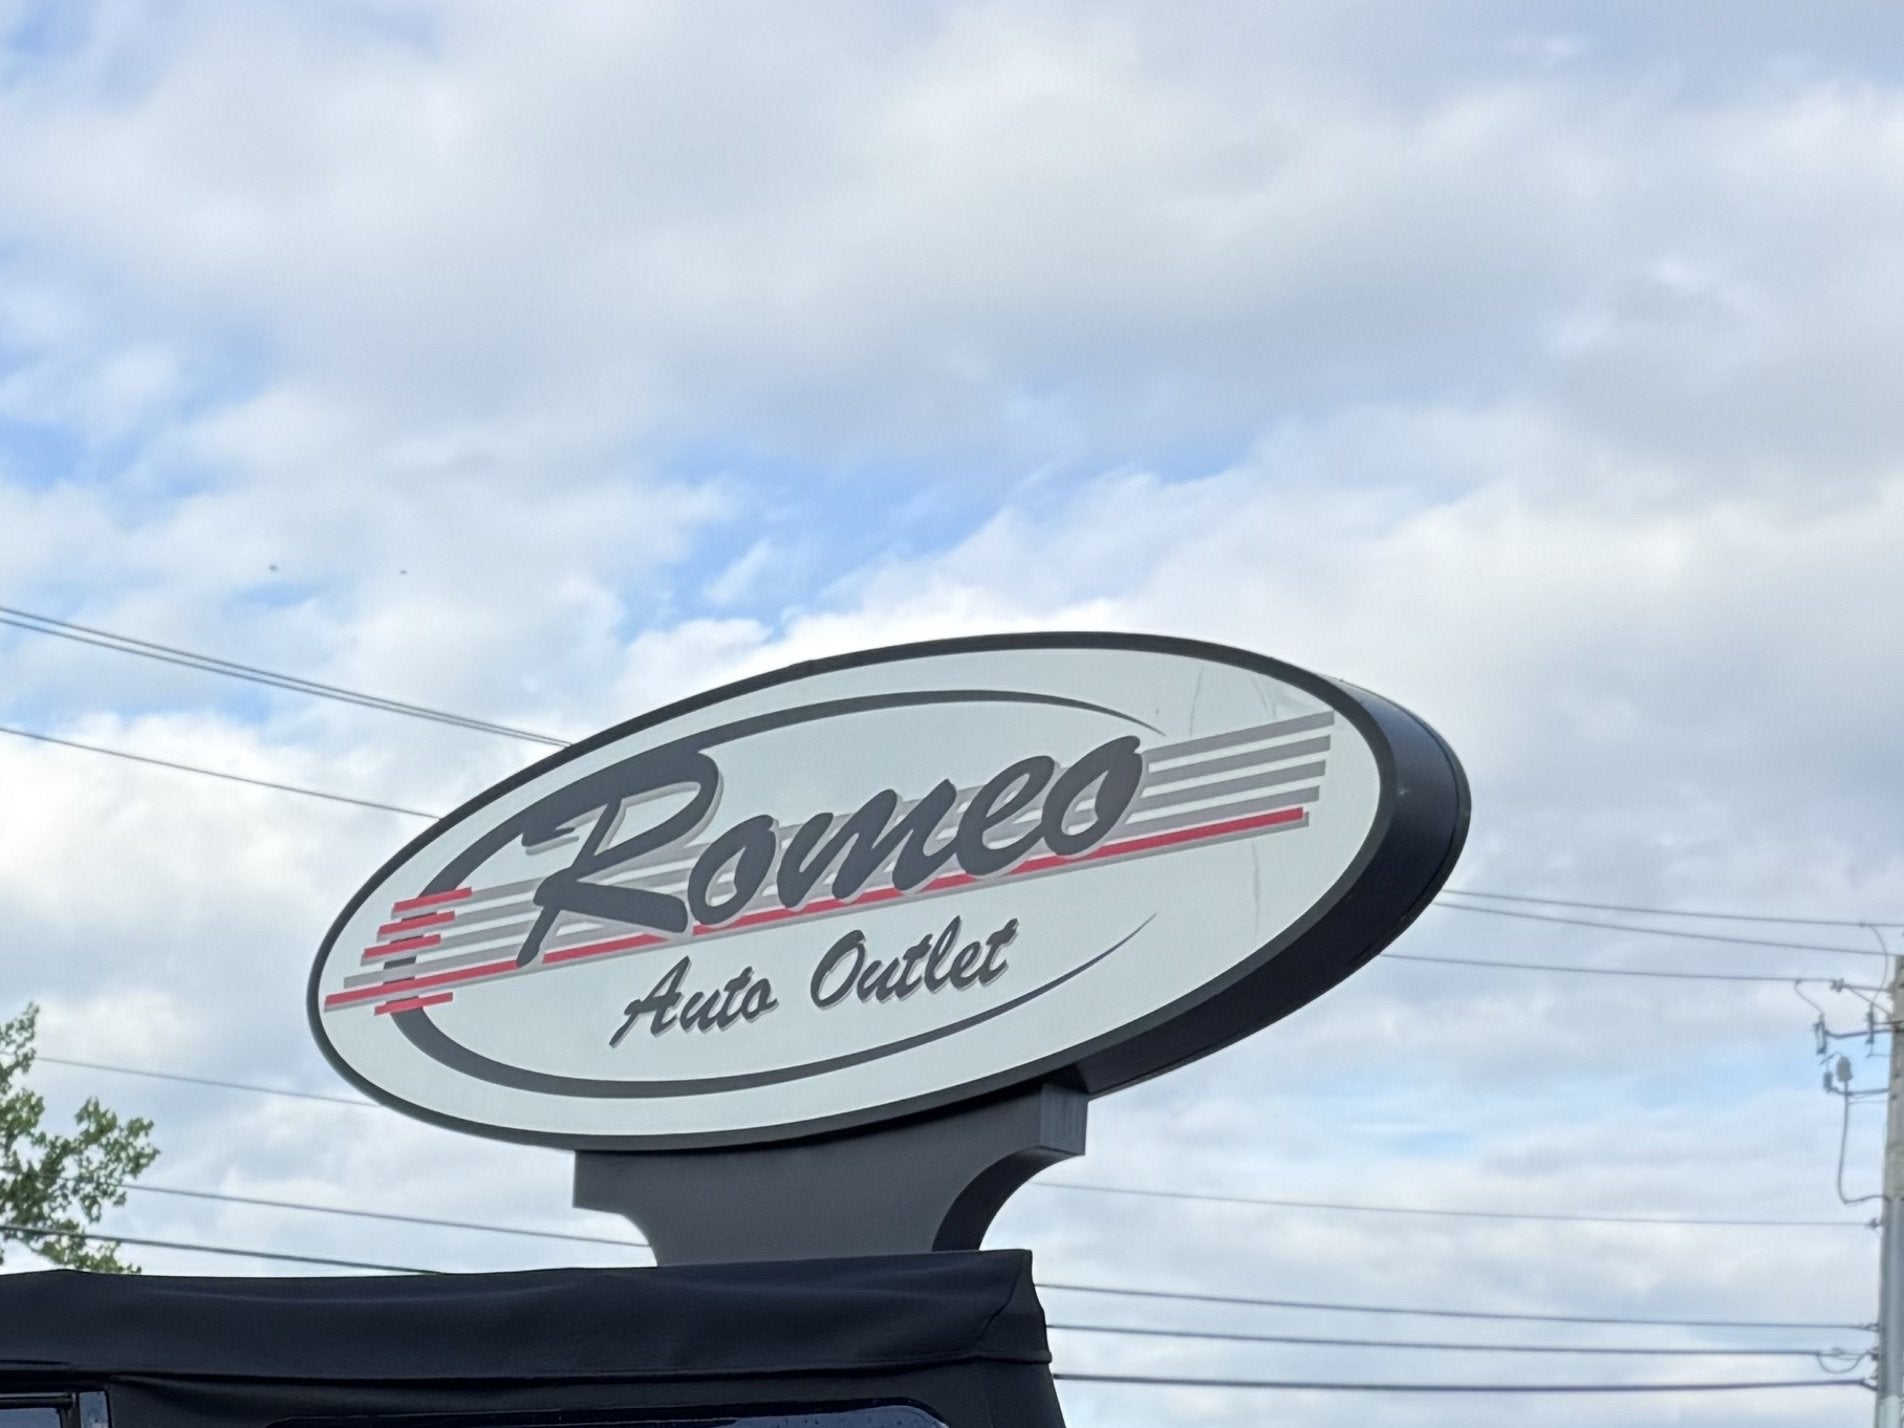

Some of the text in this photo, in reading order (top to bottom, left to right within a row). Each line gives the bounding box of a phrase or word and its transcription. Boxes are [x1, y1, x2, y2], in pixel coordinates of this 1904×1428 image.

[516, 735, 1143, 968] Romeo
[609, 915, 1020, 1048] Auto Outlet
